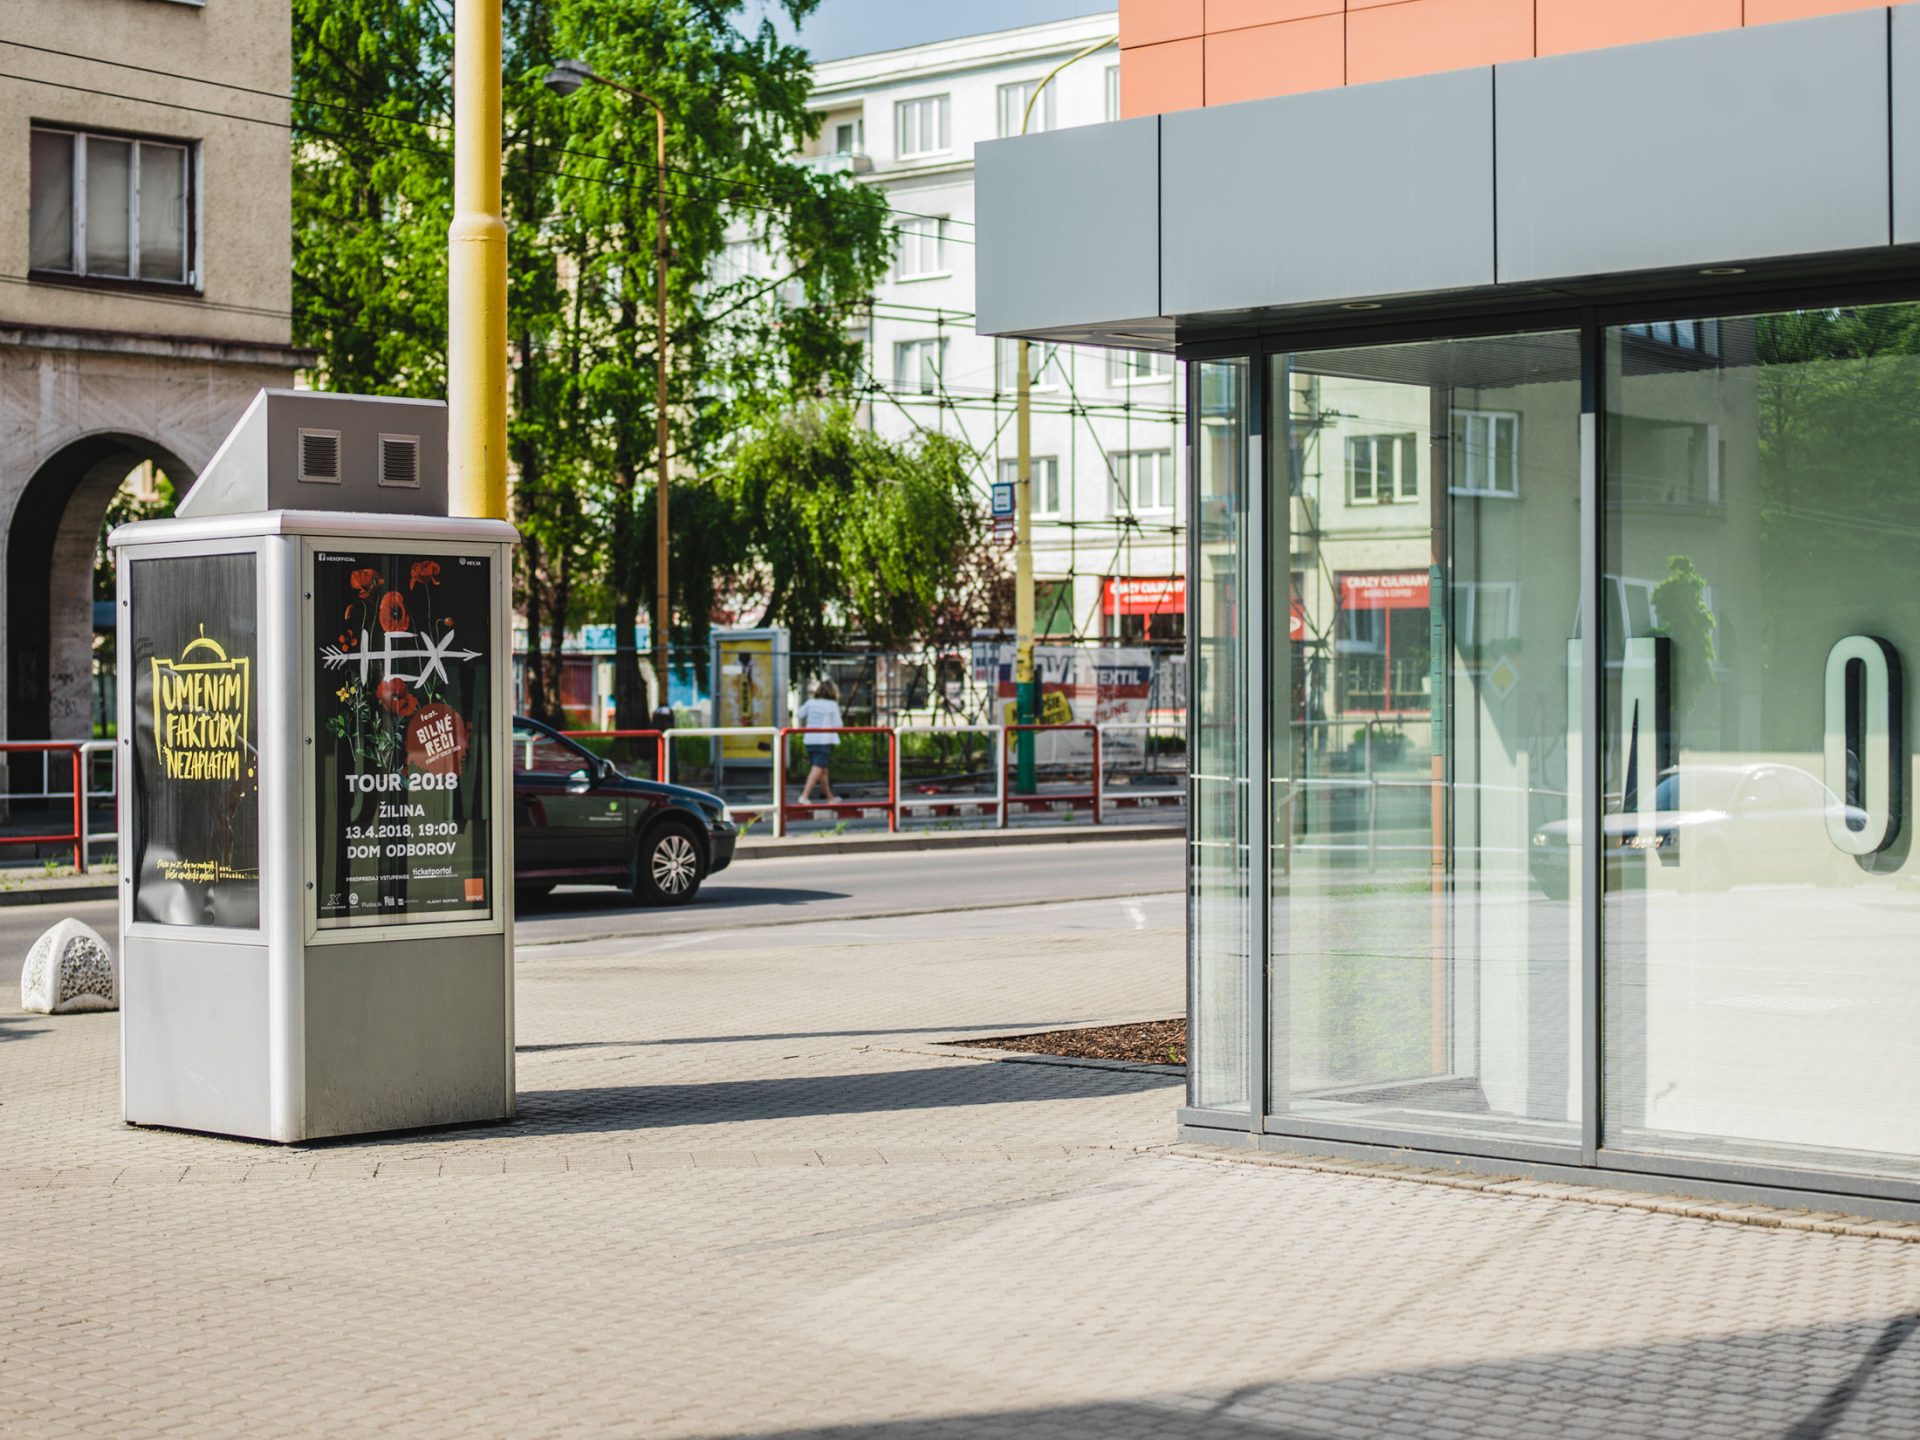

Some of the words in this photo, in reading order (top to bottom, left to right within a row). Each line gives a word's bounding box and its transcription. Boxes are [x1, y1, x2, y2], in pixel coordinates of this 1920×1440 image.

[1347, 576, 1379, 589] CRAZY
[1381, 574, 1429, 587] CULINARY
[162, 673, 241, 713] UMENÍM
[421, 710, 438, 721] feat.
[166, 711, 241, 748] FAKTÚRY
[166, 749, 239, 781] NEZAPLATÍM
[345, 774, 401, 792] TOUR
[408, 772, 458, 791] 2018
[379, 801, 425, 818] ŽILINA
[345, 824, 414, 839] 13.4.2018,
[418, 822, 457, 836] 19:00
[347, 845, 380, 858] DOM
[386, 842, 456, 857] ODBOROV
[413, 867, 452, 875] ticketportal
